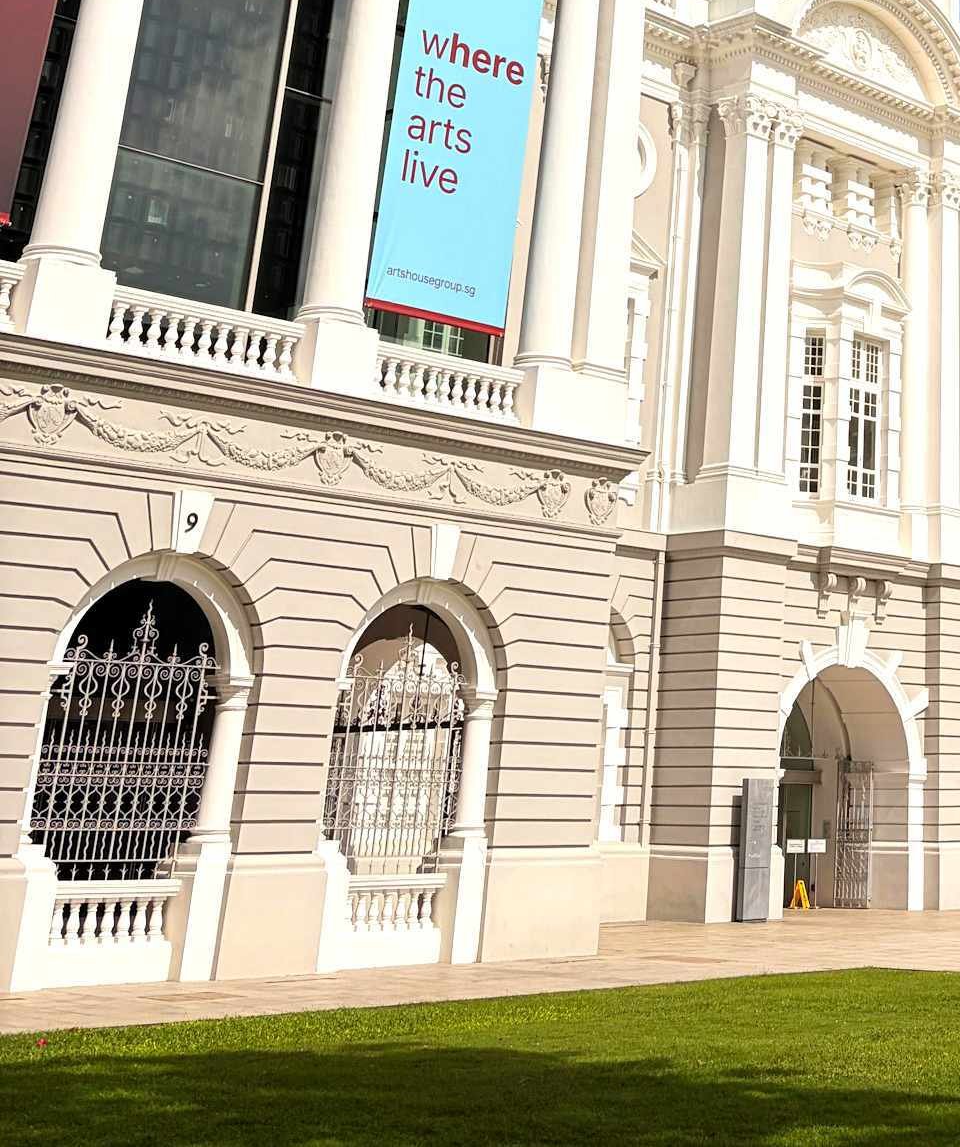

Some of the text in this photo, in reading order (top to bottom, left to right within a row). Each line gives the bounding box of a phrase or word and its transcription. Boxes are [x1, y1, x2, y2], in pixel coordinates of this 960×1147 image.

[422, 29, 525, 85] where
[415, 66, 466, 109] the
[407, 114, 472, 154] arts
[401, 149, 458, 194] live
[386, 267, 476, 298] artshousegroup.sg
[184, 512, 199, 533] 9
